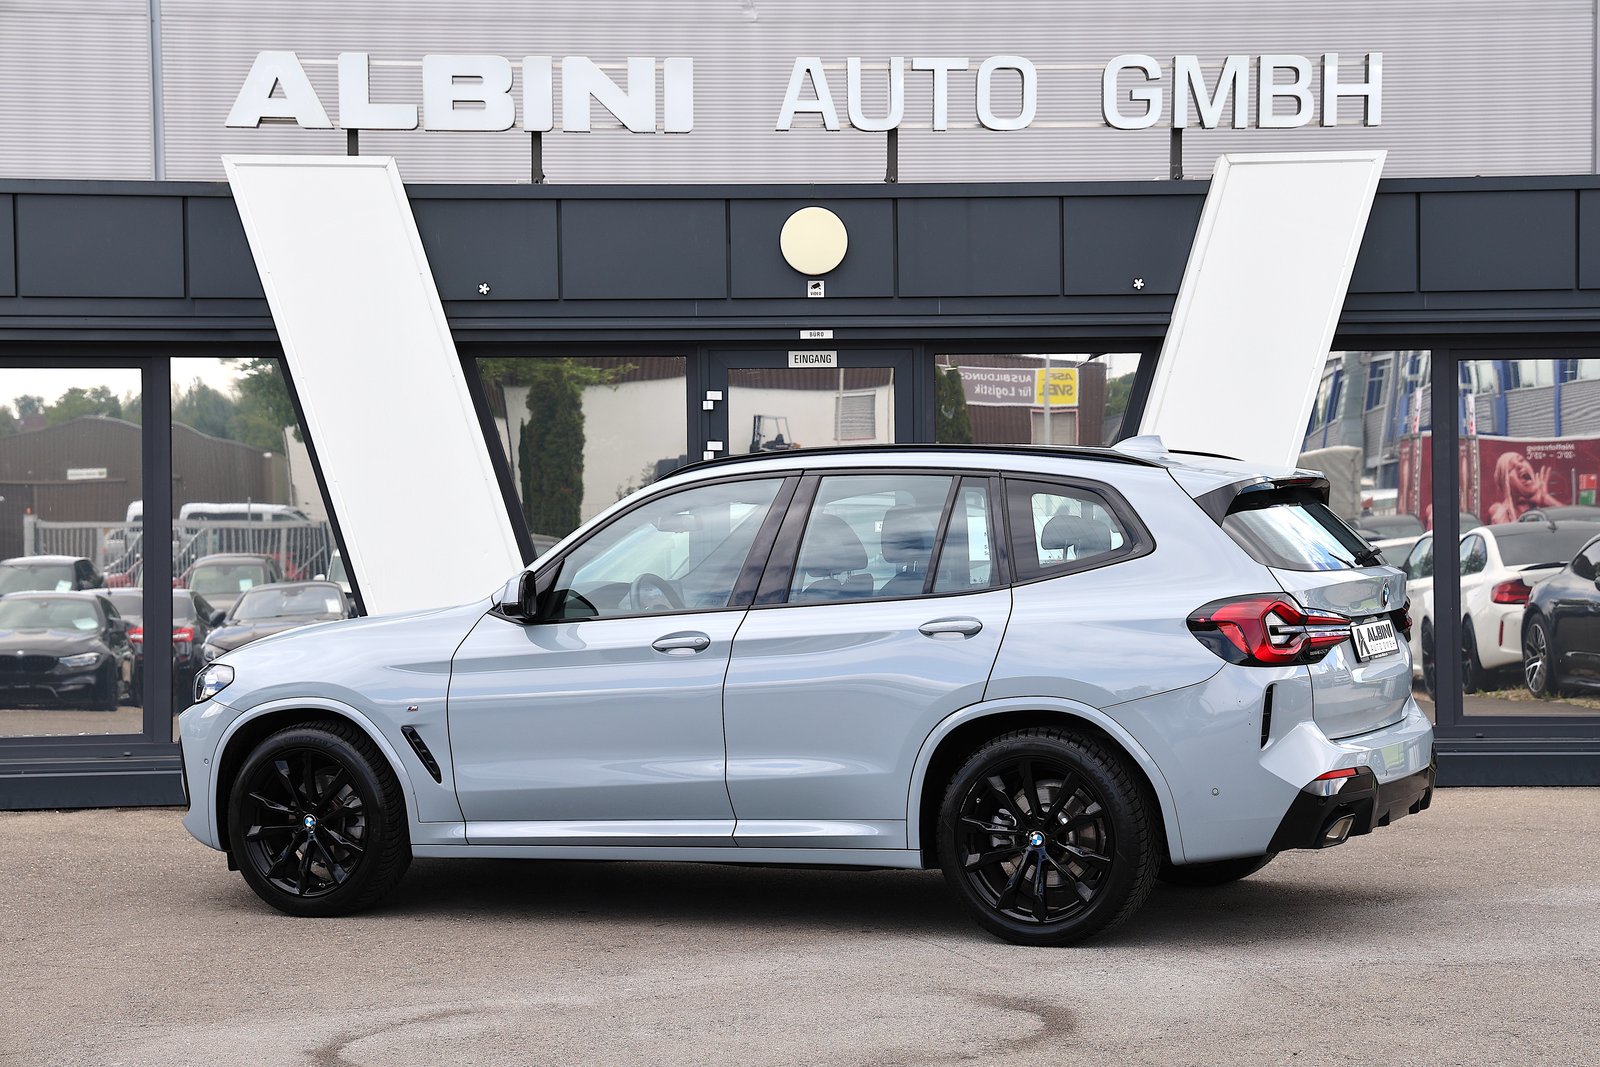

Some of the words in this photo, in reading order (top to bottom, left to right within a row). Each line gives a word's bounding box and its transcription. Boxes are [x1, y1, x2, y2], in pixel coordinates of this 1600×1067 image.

[225, 51, 694, 134] ALBINI
[775, 54, 1038, 132] AUTO
[1101, 52, 1384, 130] GMBH
[794, 354, 832, 363] EINGANG
[1366, 623, 1393, 642] ALBINI
